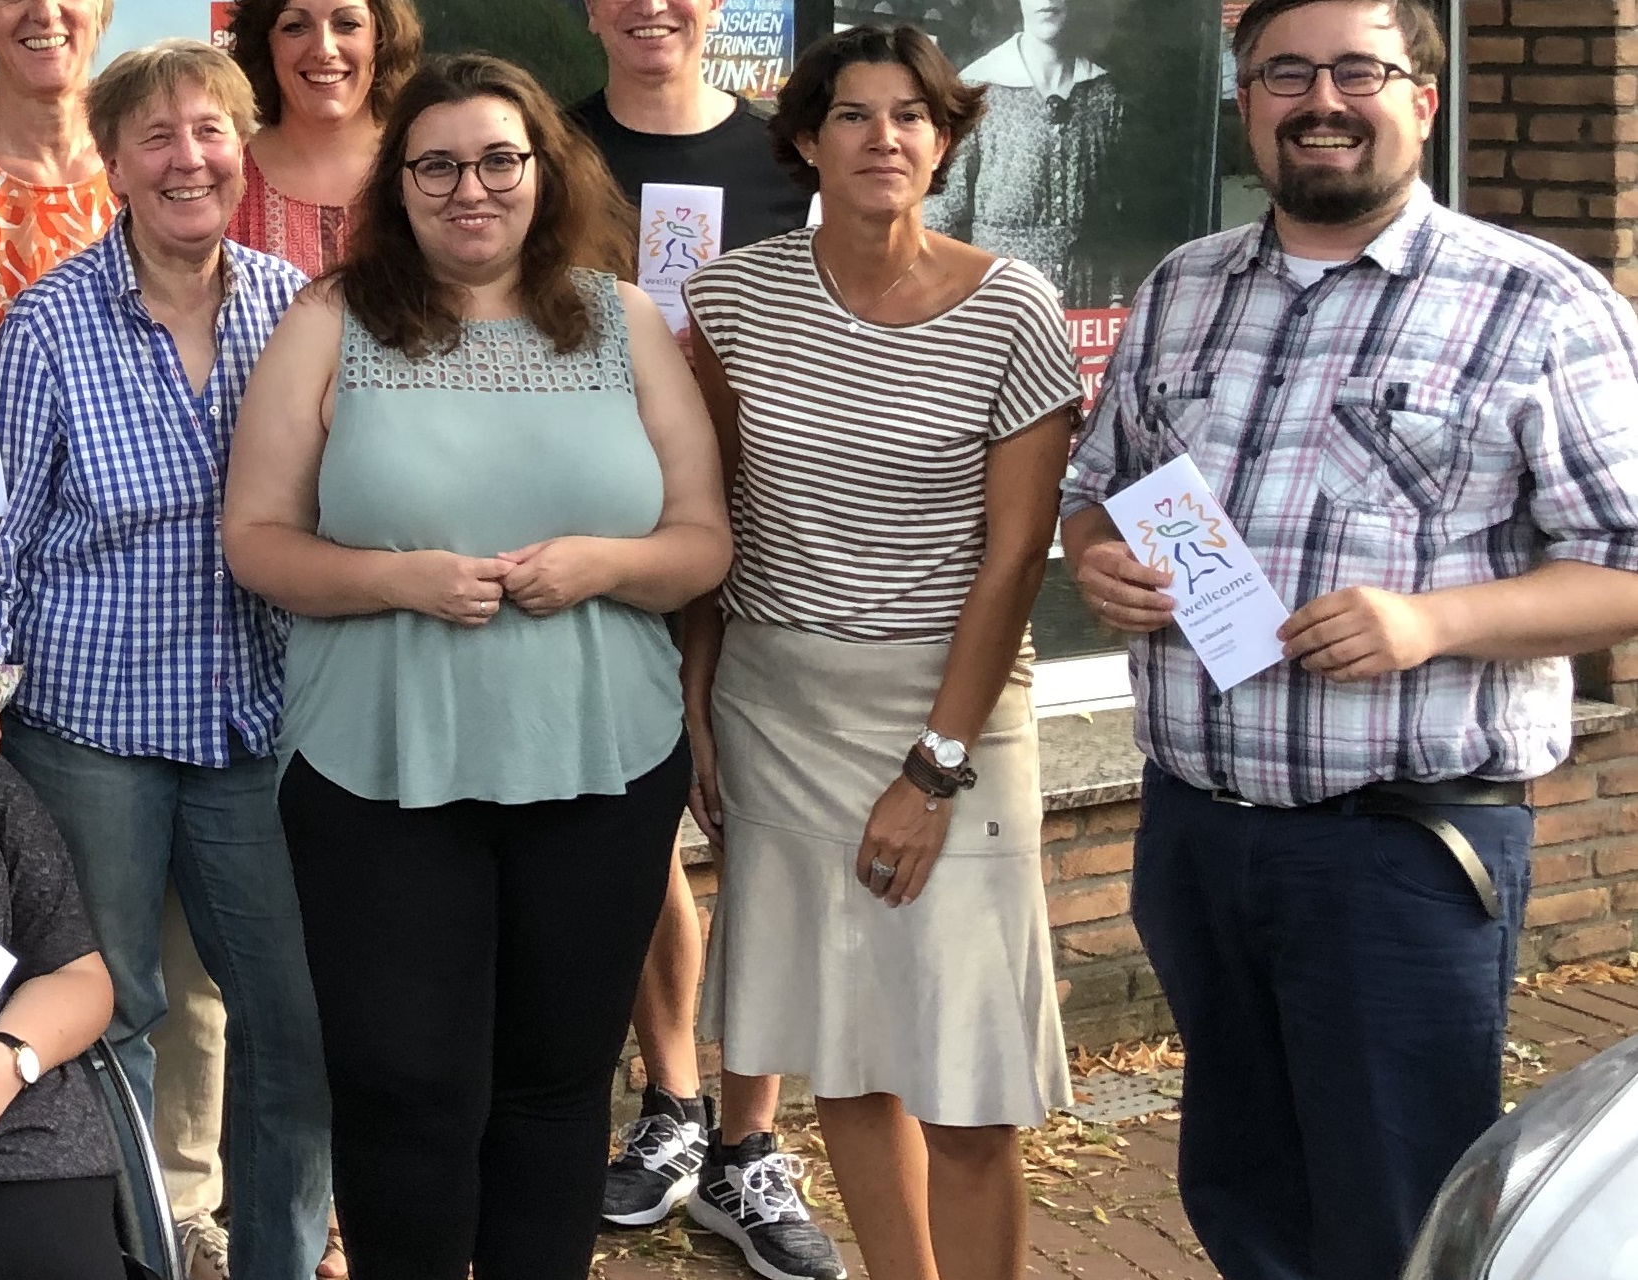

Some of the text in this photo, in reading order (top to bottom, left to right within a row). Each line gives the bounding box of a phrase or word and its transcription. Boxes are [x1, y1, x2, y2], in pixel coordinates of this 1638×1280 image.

[707, 12, 785, 34] NSCHEN
[213, 30, 237, 48] SP
[703, 34, 784, 57] RTRINKEN!
[1181, 572, 1254, 617] wellcome
